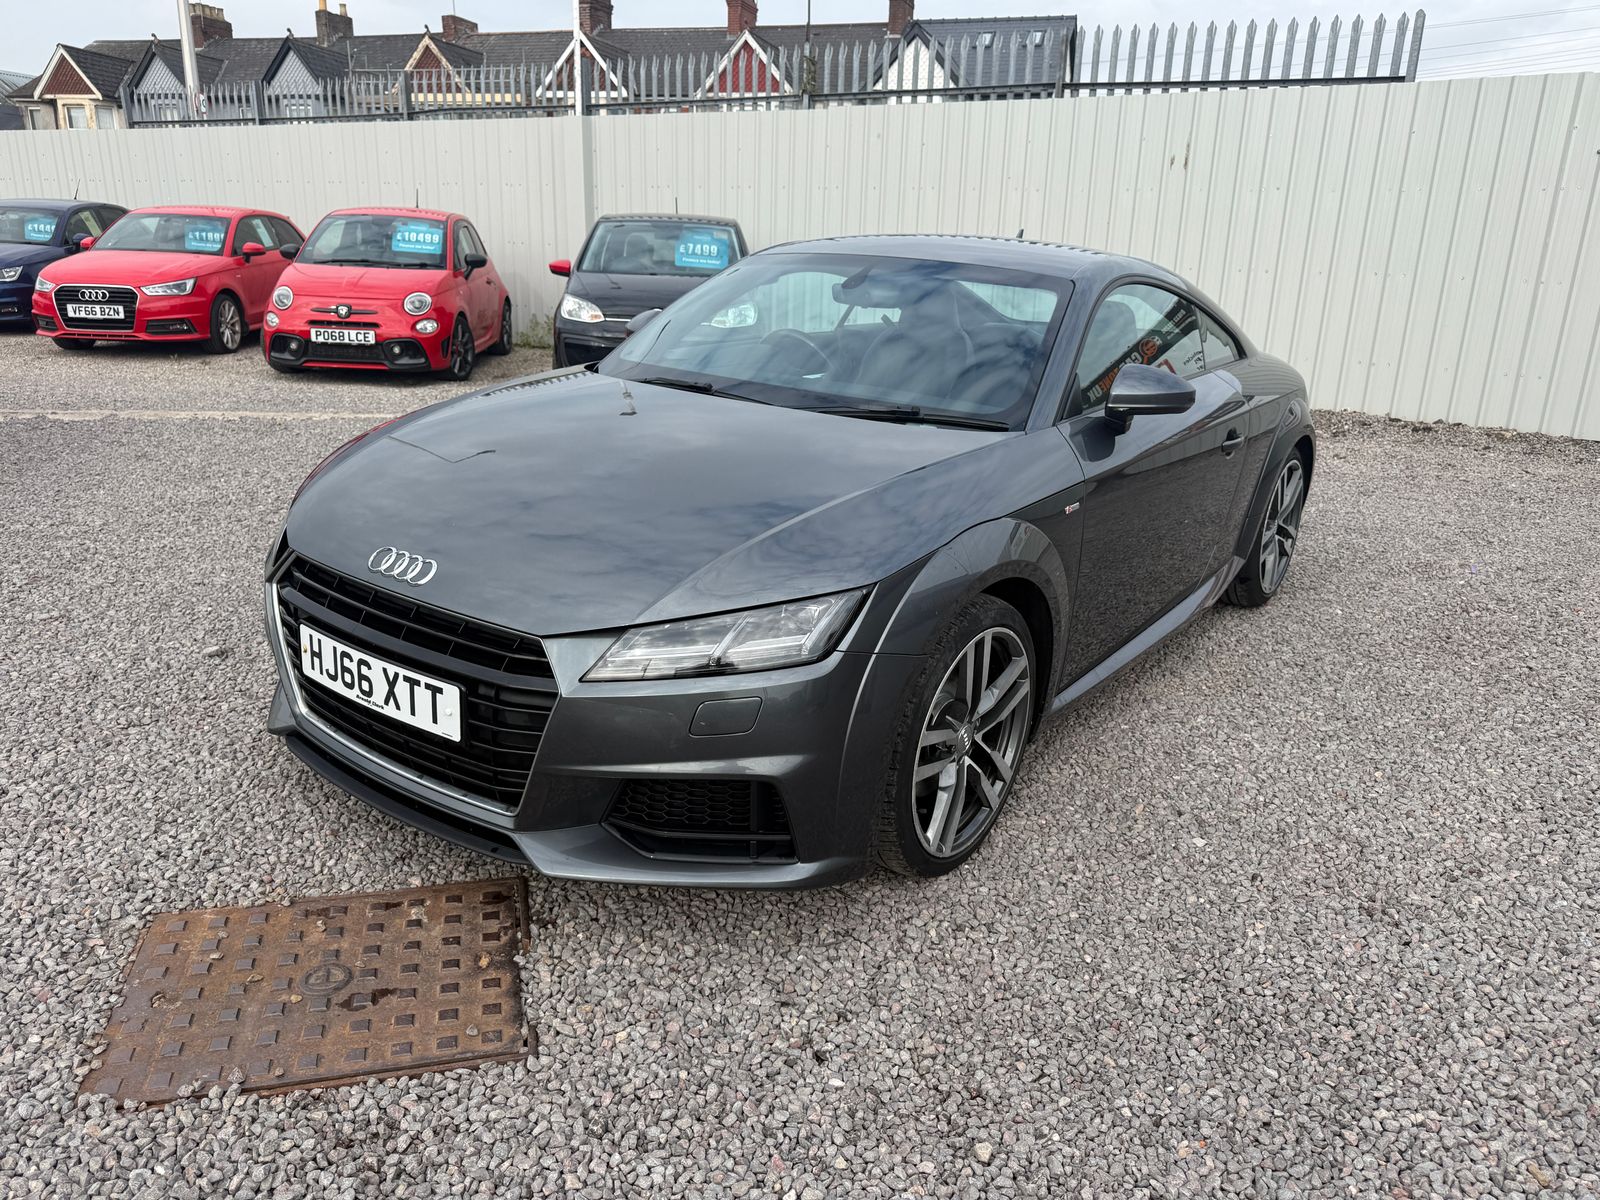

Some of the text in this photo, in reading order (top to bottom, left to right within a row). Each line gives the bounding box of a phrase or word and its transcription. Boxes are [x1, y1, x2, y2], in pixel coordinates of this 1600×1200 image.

[396, 231, 440, 243] £10499
[680, 243, 718, 256] £7499
[71, 305, 120, 317] VF66 BZN
[315, 330, 371, 343] PO68 LCE
[309, 633, 444, 725] HJ66 XTT
